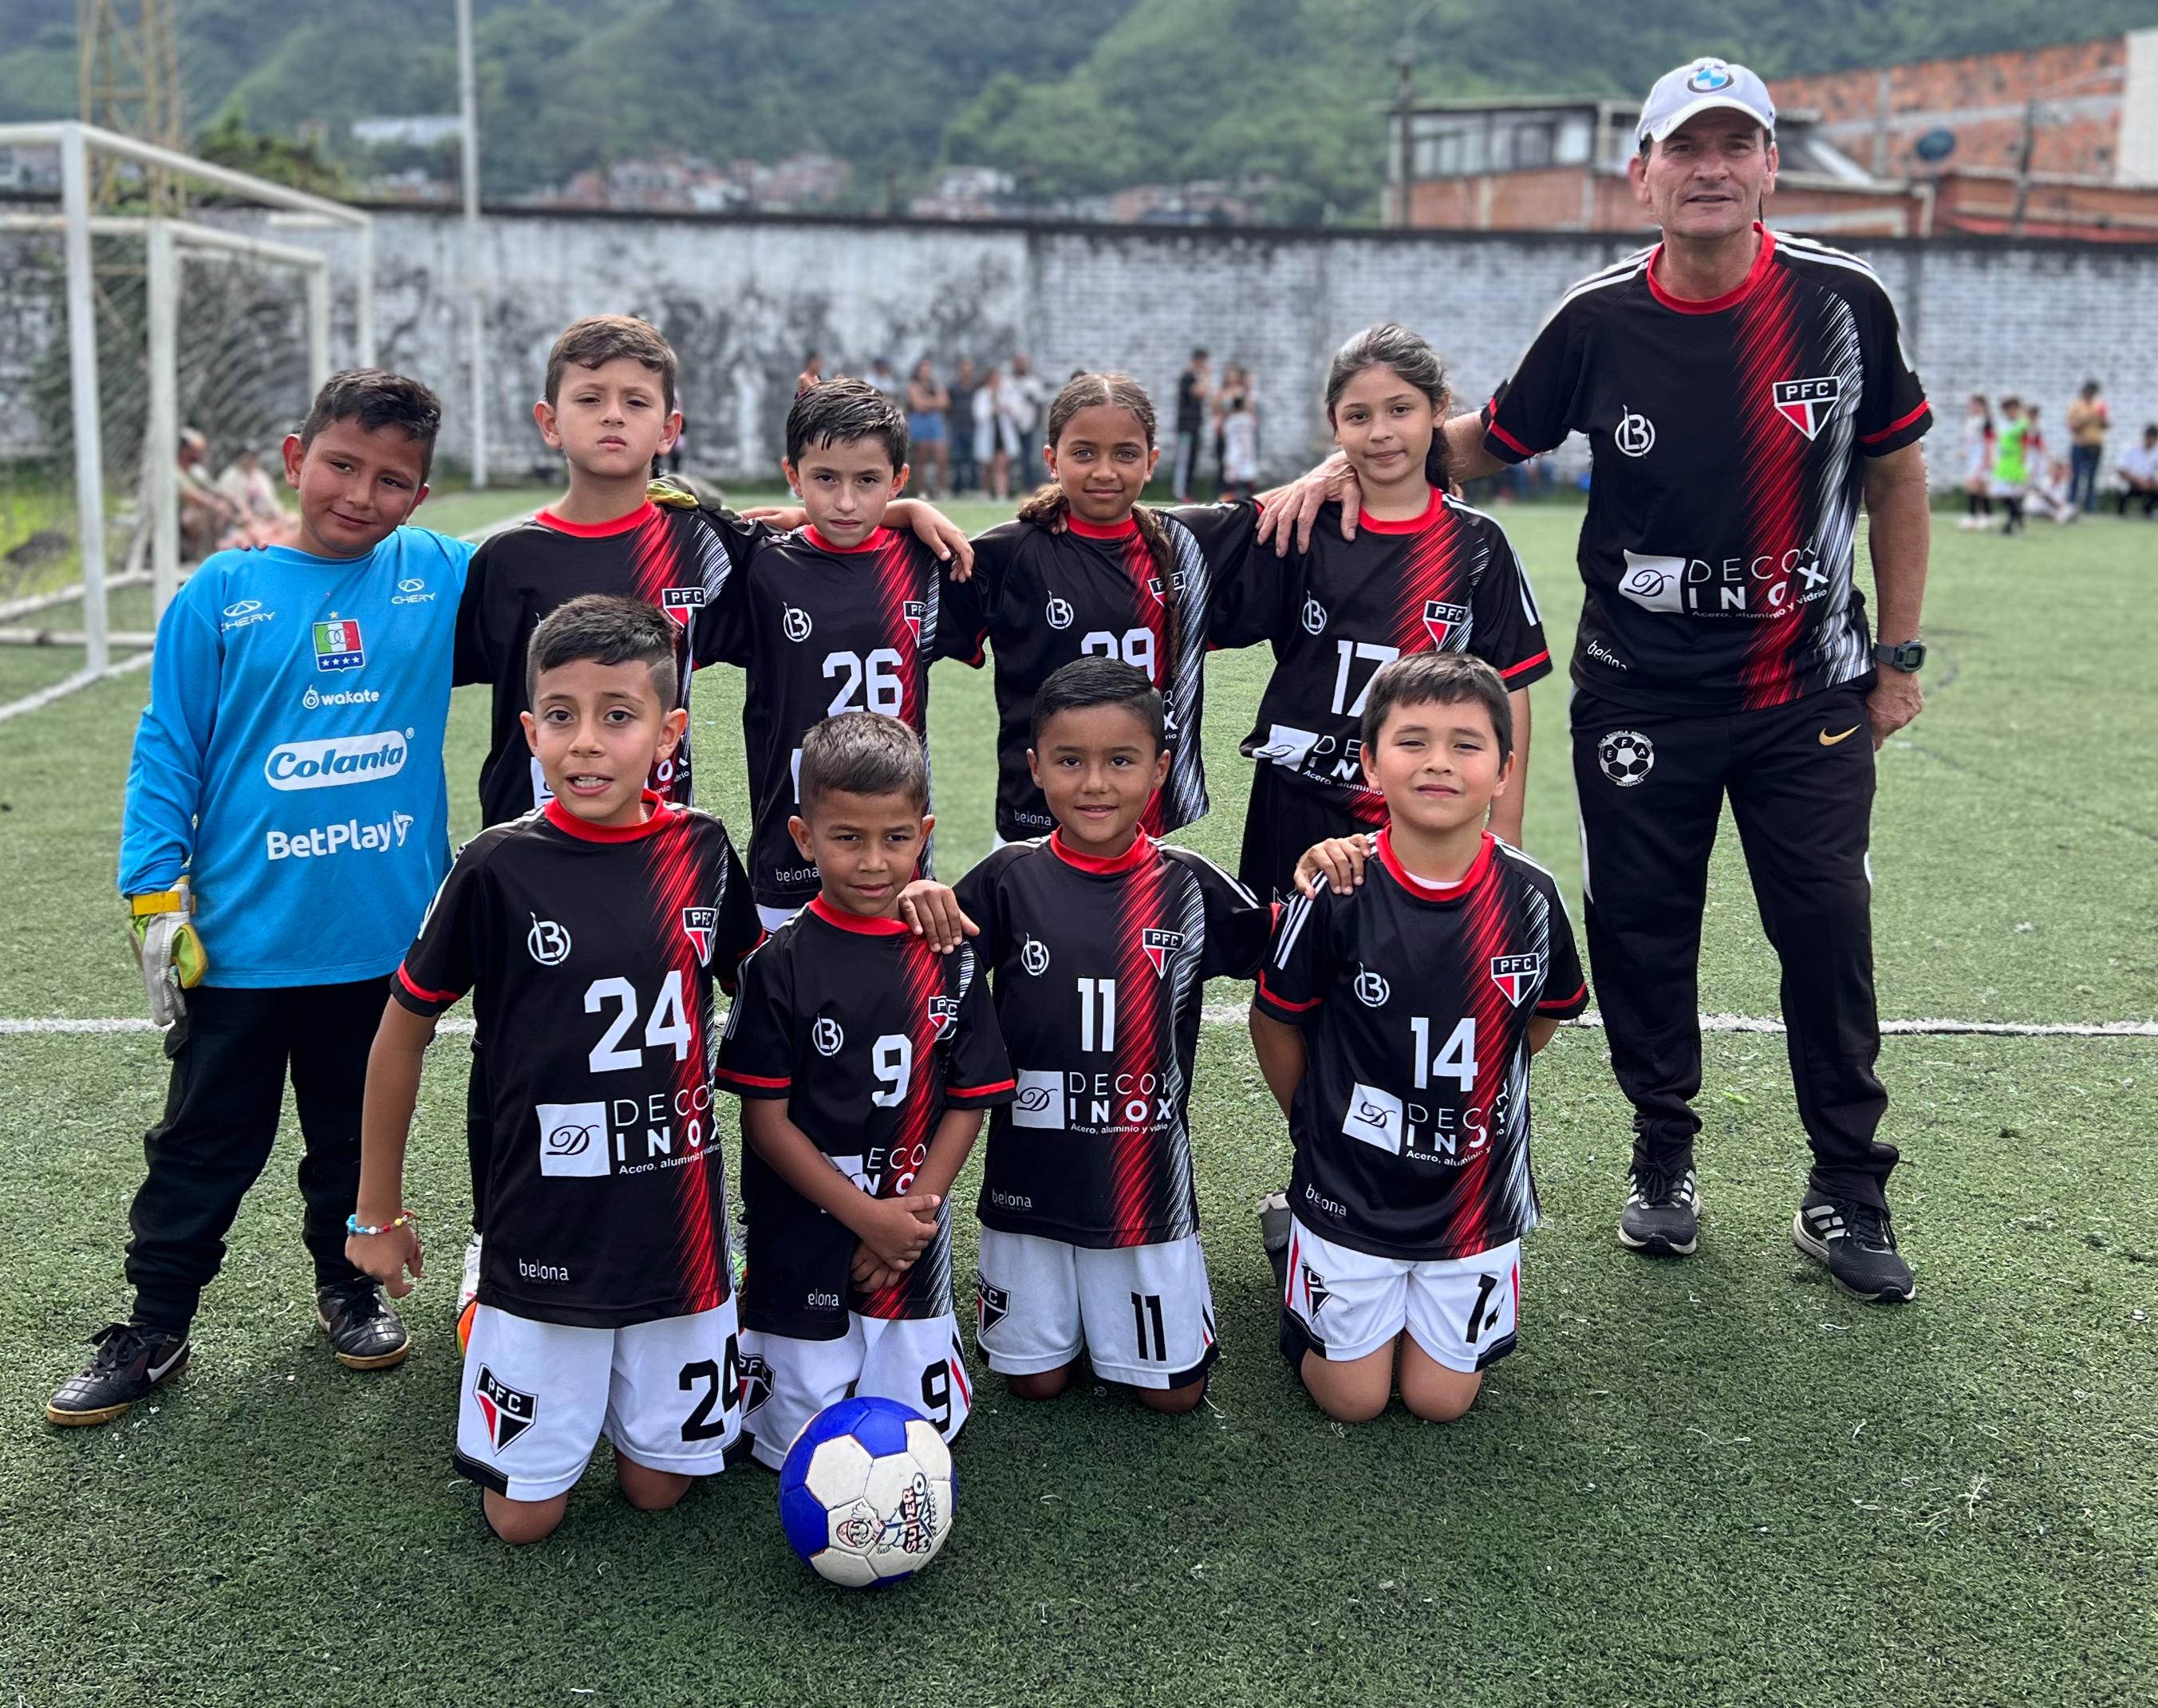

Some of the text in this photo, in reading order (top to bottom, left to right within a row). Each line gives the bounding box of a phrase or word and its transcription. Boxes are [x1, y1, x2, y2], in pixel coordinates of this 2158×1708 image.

[1785, 381, 1829, 400] PFC
[391, 592, 436, 605] CHERY
[671, 591, 702, 604] PFC
[1434, 606, 1464, 621] PFC
[822, 648, 903, 717] 26
[1330, 639, 1400, 718] 17
[321, 688, 380, 705] wakate
[266, 744, 404, 780] Colanta
[1014, 807, 1052, 826] belona
[266, 815, 393, 862] BetPlay
[775, 866, 821, 882] belona
[692, 911, 712, 926] PFC
[1151, 933, 1178, 947] PFC
[1500, 957, 1533, 972] PFC
[583, 969, 692, 1073] 24
[1076, 977, 1116, 1052] 11
[1410, 1016, 1478, 1092] 14
[871, 1032, 913, 1107] 9
[1070, 1098, 1173, 1123] INOX
[1142, 1126, 1149, 1134] y
[867, 1143, 926, 1170] ECO
[1406, 1150, 1442, 1164] Acero,
[618, 1163, 657, 1174] Acero,
[992, 1188, 1032, 1208] belona
[519, 1258, 570, 1281] belona
[807, 1288, 839, 1307] elona
[1130, 1291, 1167, 1362] 11
[487, 1376, 522, 1413] PFC
[921, 1358, 951, 1434] 9
